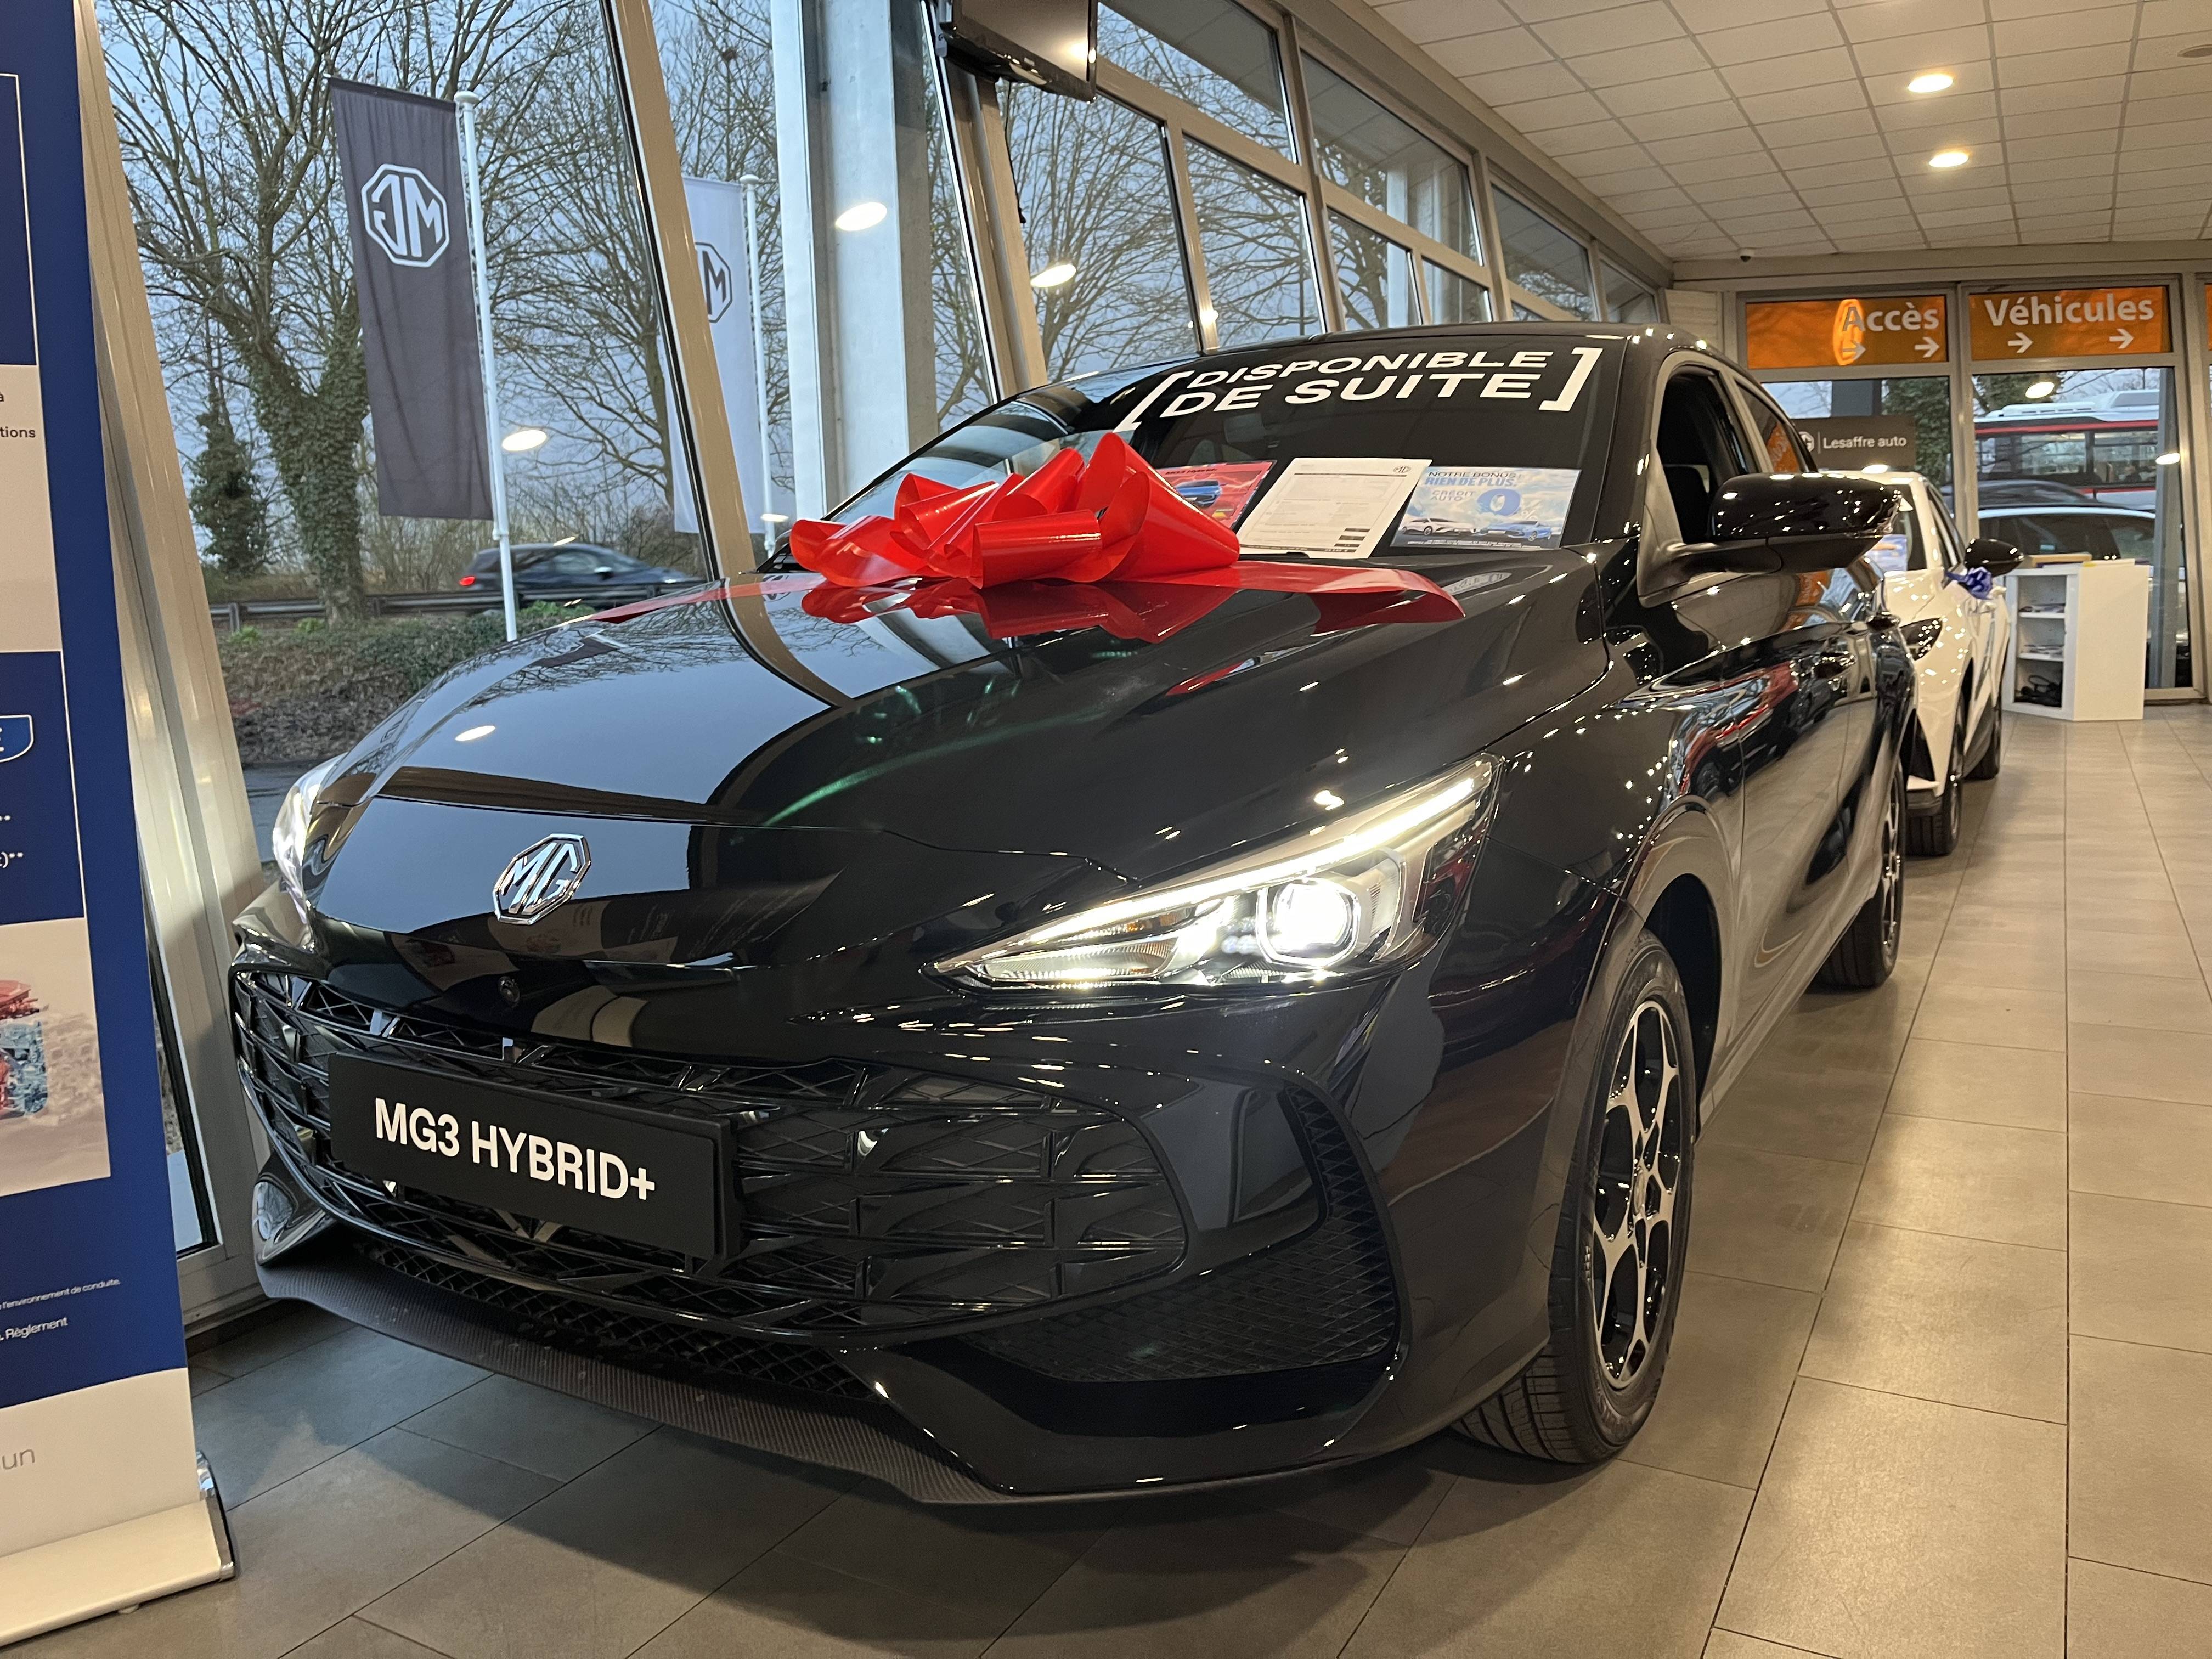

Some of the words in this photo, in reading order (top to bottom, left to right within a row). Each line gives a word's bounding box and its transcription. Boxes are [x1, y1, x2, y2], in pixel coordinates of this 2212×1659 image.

[1842, 301, 1940, 331] Accès
[1984, 293, 2154, 327] Véhicules
[1186, 351, 1554, 389] DISPONIBLE
[1159, 384, 1274, 419] DE
[1284, 373, 1542, 405] SUITE
[1823, 436, 1875, 449] Lesaffre
[1878, 436, 1908, 447] auto
[1425, 477, 1457, 486] RIEN
[1459, 477, 1476, 486] DE
[1477, 477, 1517, 487] PLUS.
[500, 842, 583, 915] MG
[375, 1097, 460, 1158] MG3
[471, 1120, 656, 1201] HYBRID+
[2, 1288, 70, 1310] l'environnement
[70, 1286, 82, 1295] de
[5, 1317, 69, 1340] Règlement
[1, 1449, 35, 1470] un
